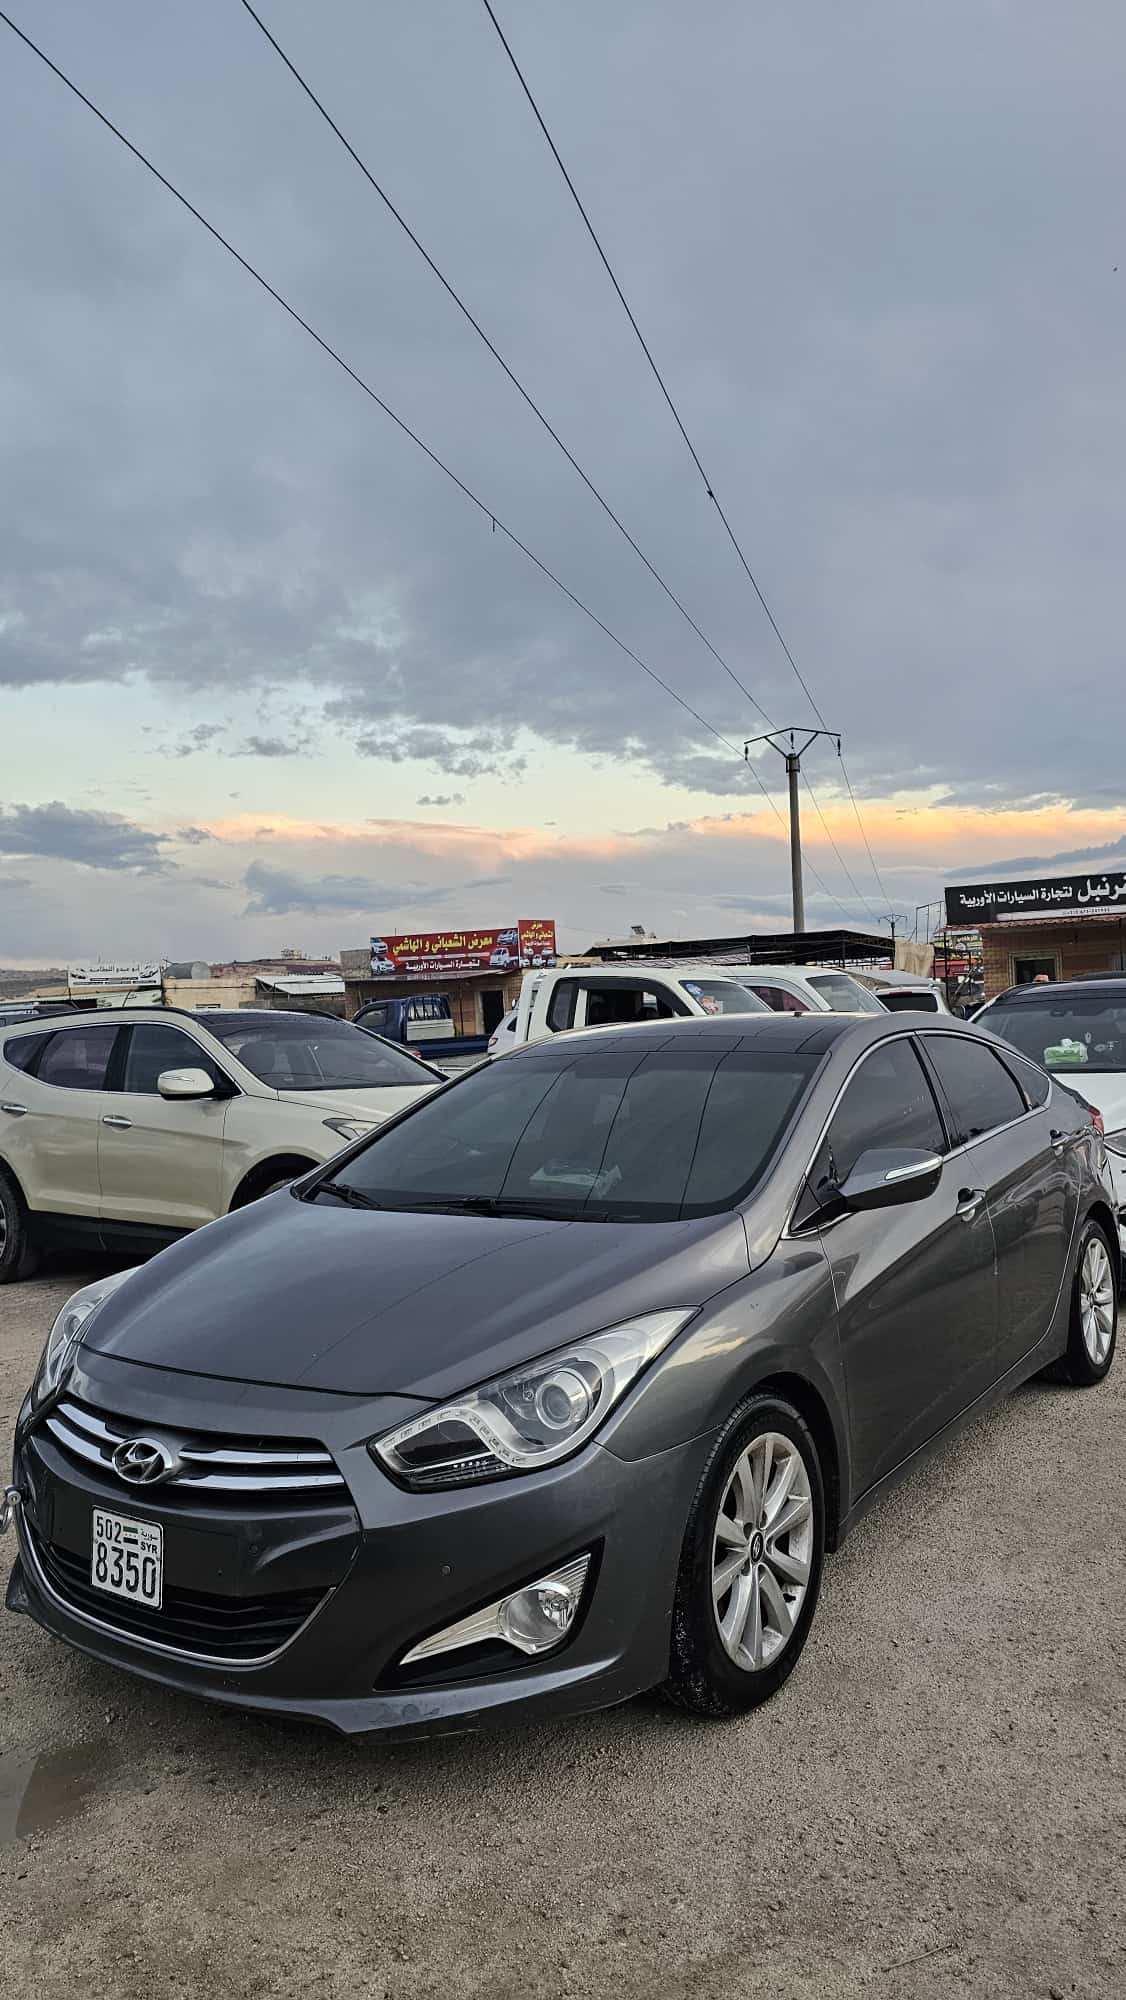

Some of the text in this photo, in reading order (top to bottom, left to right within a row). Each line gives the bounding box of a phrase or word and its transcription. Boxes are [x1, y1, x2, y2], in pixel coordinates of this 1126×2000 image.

[997, 888, 1039, 904] السيارات
[1040, 886, 1073, 901] لتجارة
[392, 934, 493, 956] معرض الشعباني و الهاشمي
[96, 1515, 122, 1544] 502
[140, 1541, 158, 1555] SYR
[96, 1542, 156, 1599] 8350
